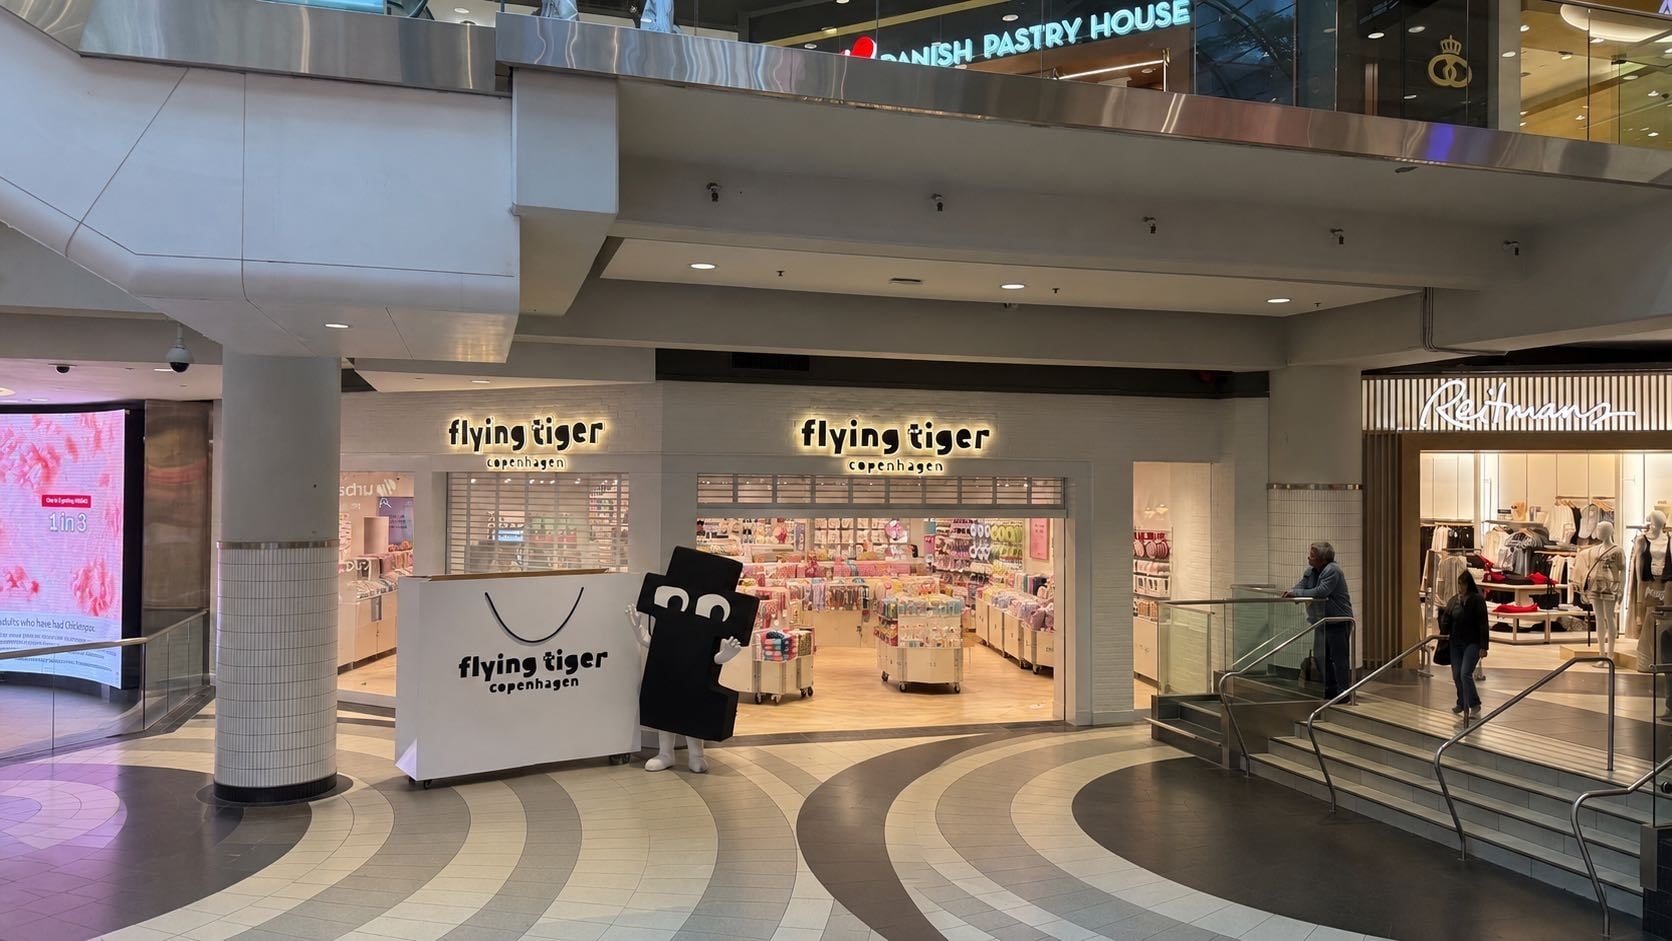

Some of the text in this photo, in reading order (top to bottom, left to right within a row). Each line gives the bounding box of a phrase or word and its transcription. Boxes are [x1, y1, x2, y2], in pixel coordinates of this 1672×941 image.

[880, 0, 1191, 68] ANISH PASTRY HOUSE
[1419, 378, 1636, 429] Reitmans
[449, 417, 603, 451] flying tiger
[802, 419, 990, 455] flying tiger
[486, 456, 565, 470] copenhagen
[849, 460, 943, 474] copenhagen
[49, 512, 87, 532] 1 in 3
[20, 618, 35, 628] who
[36, 618, 52, 630] have
[52, 619, 64, 630] had
[458, 648, 608, 681] flying tiger
[489, 677, 579, 694] copenhagen
